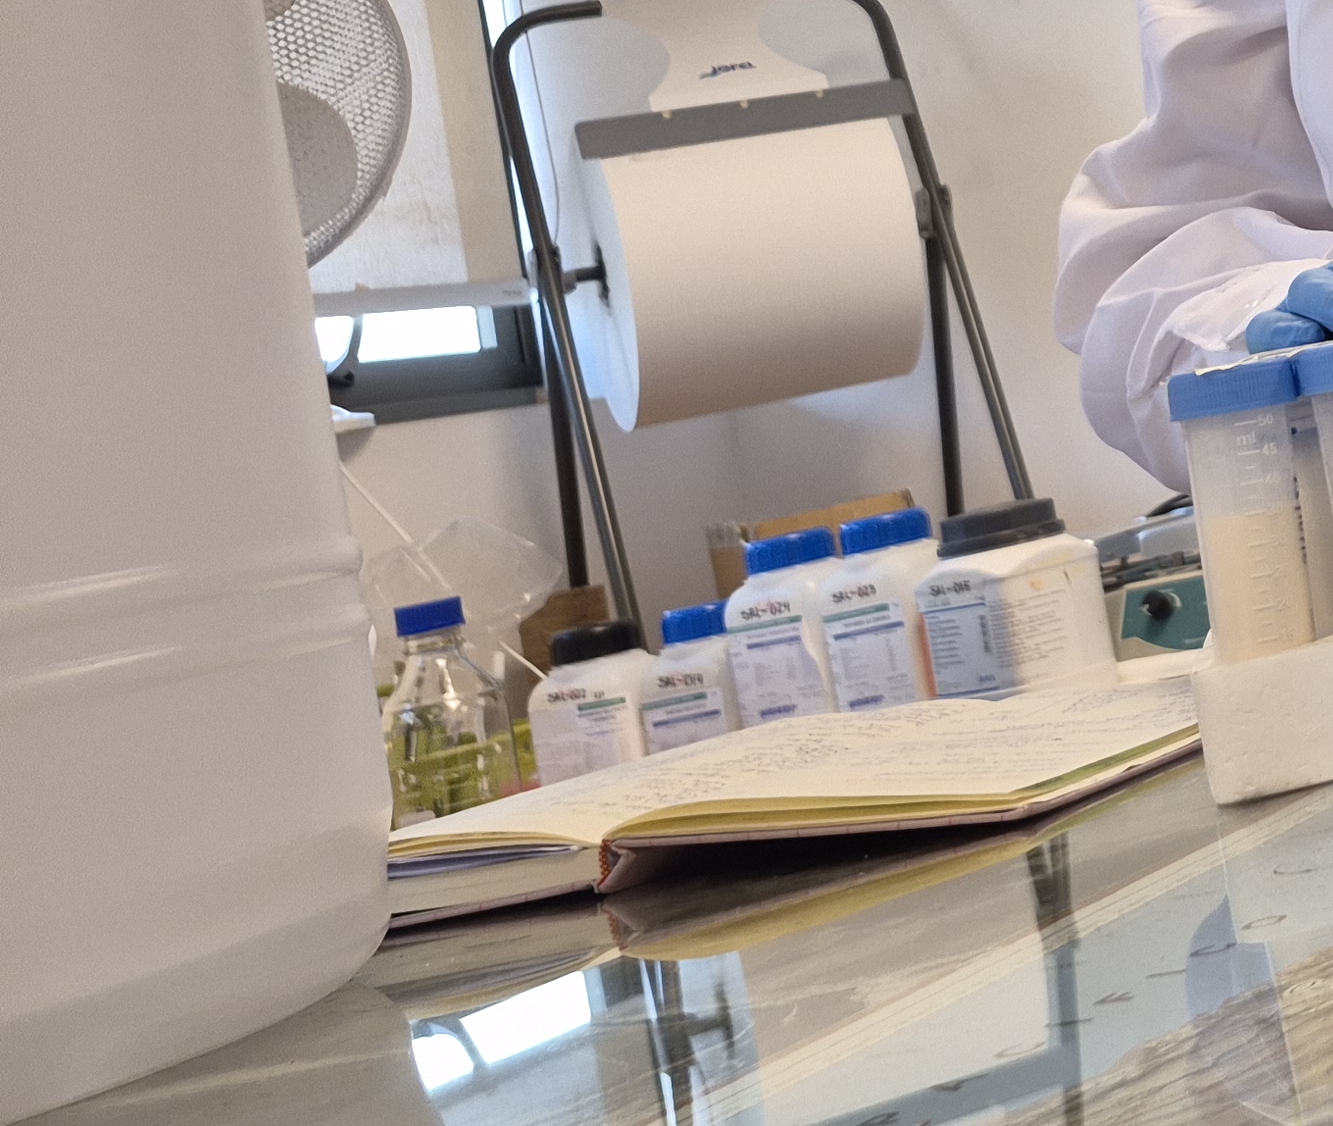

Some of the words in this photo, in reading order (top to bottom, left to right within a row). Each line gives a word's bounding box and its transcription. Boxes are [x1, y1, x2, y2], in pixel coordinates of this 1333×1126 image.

[1258, 414, 1273, 426] 50
[1236, 433, 1256, 446] ml
[1261, 443, 1278, 456] 45
[1264, 473, 1280, 485] 40
